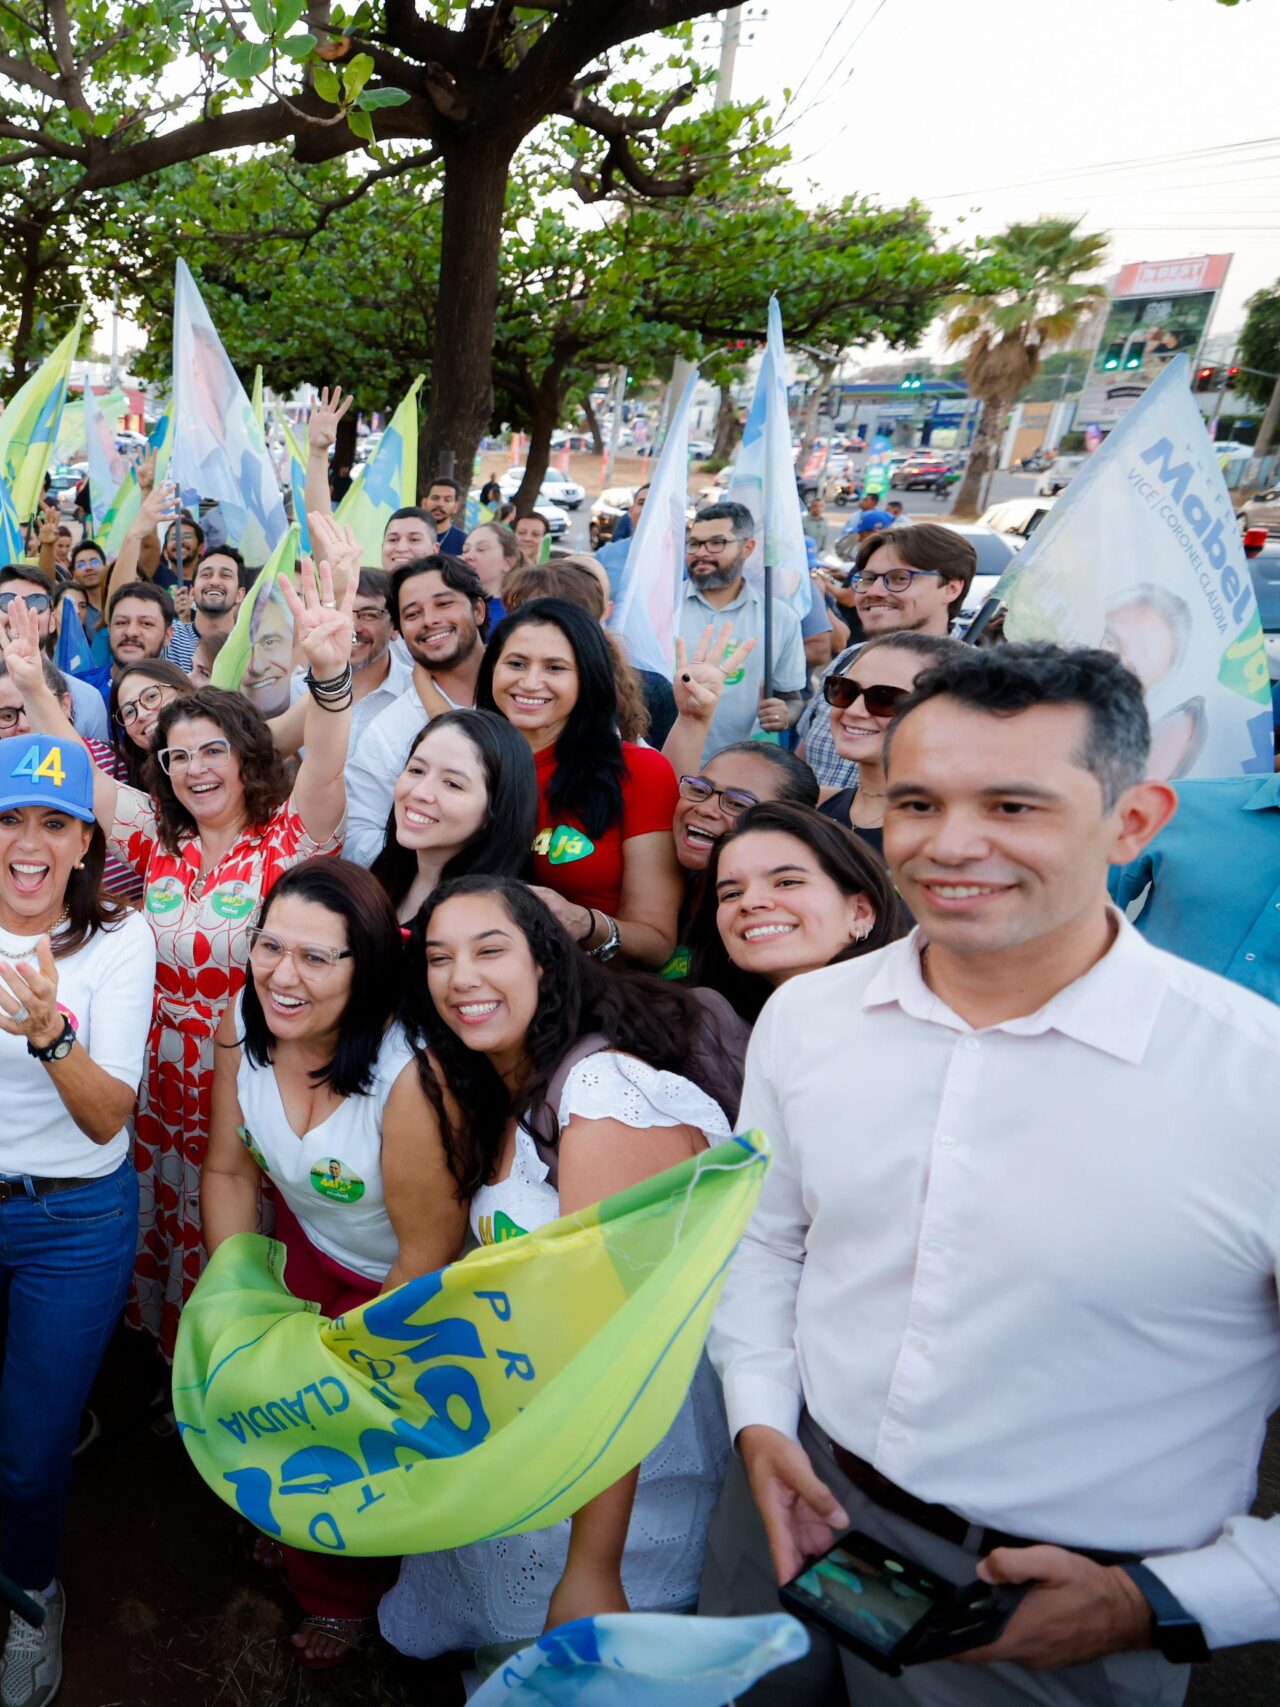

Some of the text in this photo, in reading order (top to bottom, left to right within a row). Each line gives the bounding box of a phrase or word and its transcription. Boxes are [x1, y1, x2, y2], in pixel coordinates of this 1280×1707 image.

[1127, 467, 1160, 503] VICE
[1159, 504, 1205, 576] CORONEL
[1199, 572, 1229, 637] CLÁUDIA
[1139, 436, 1253, 626] Mabel
[10, 744, 66, 787] 44
[552, 835, 584, 858] Já
[217, 1375, 351, 1445] CLÁUDIA
